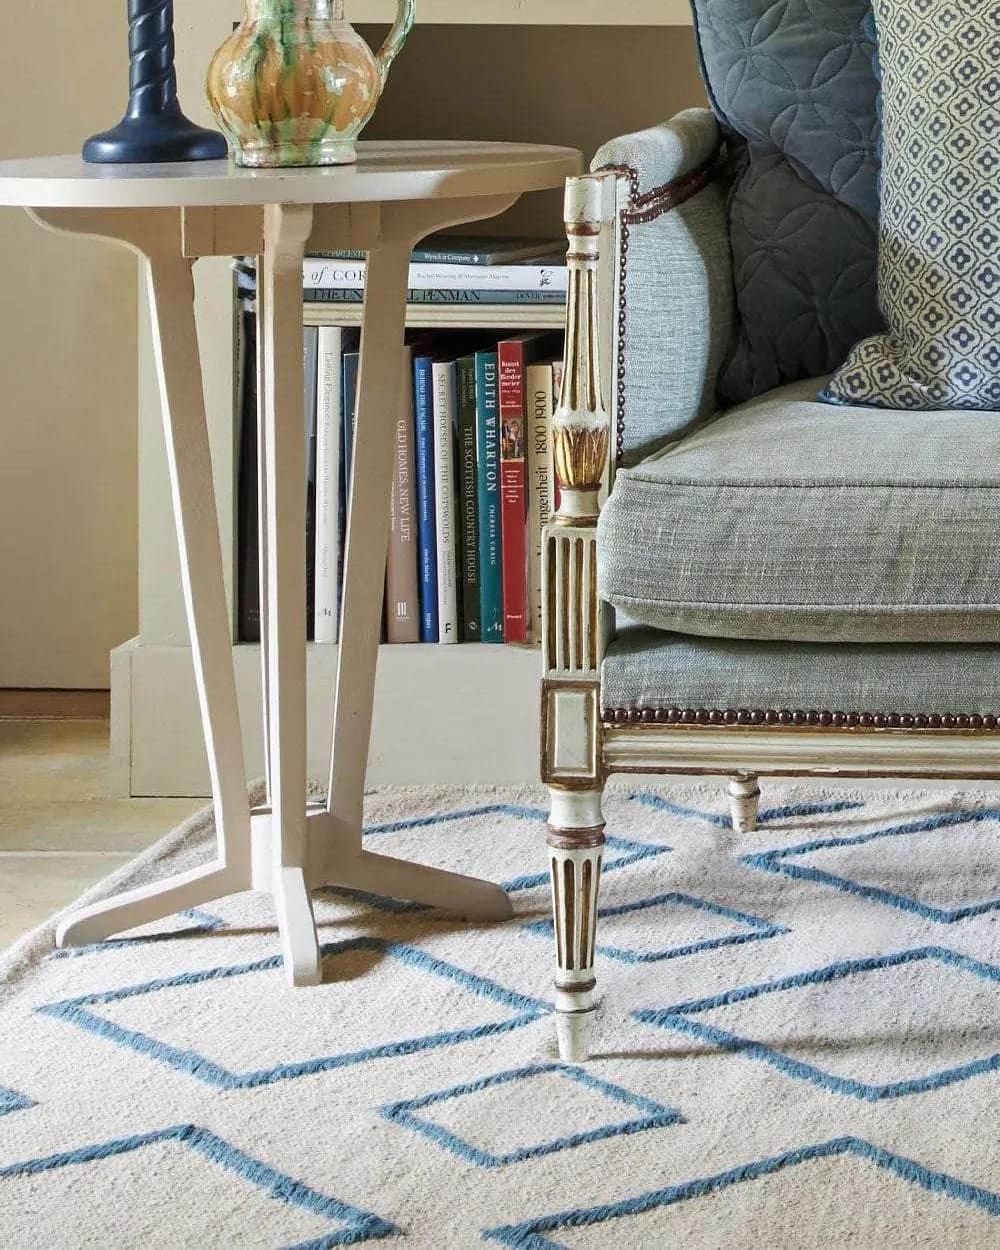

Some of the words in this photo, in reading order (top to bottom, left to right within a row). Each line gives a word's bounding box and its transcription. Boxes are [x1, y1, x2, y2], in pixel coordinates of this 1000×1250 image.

[311, 266, 328, 281] of
[313, 290, 340, 300] THE
[424, 289, 481, 300] PENMAN
[484, 363, 496, 409] EDITH
[397, 420, 407, 442] OLD
[464, 427, 473, 446] THE
[535, 391, 547, 454] 1800-1900
[397, 445, 408, 486] HOMES,
[486, 417, 497, 491] WHARTON
[465, 448, 474, 497] SCOTTISH
[399, 489, 409, 514] NEW
[400, 517, 410, 542] LIFE
[466, 500, 475, 547] COUNTRY
[467, 550, 476, 583] HOUSE
